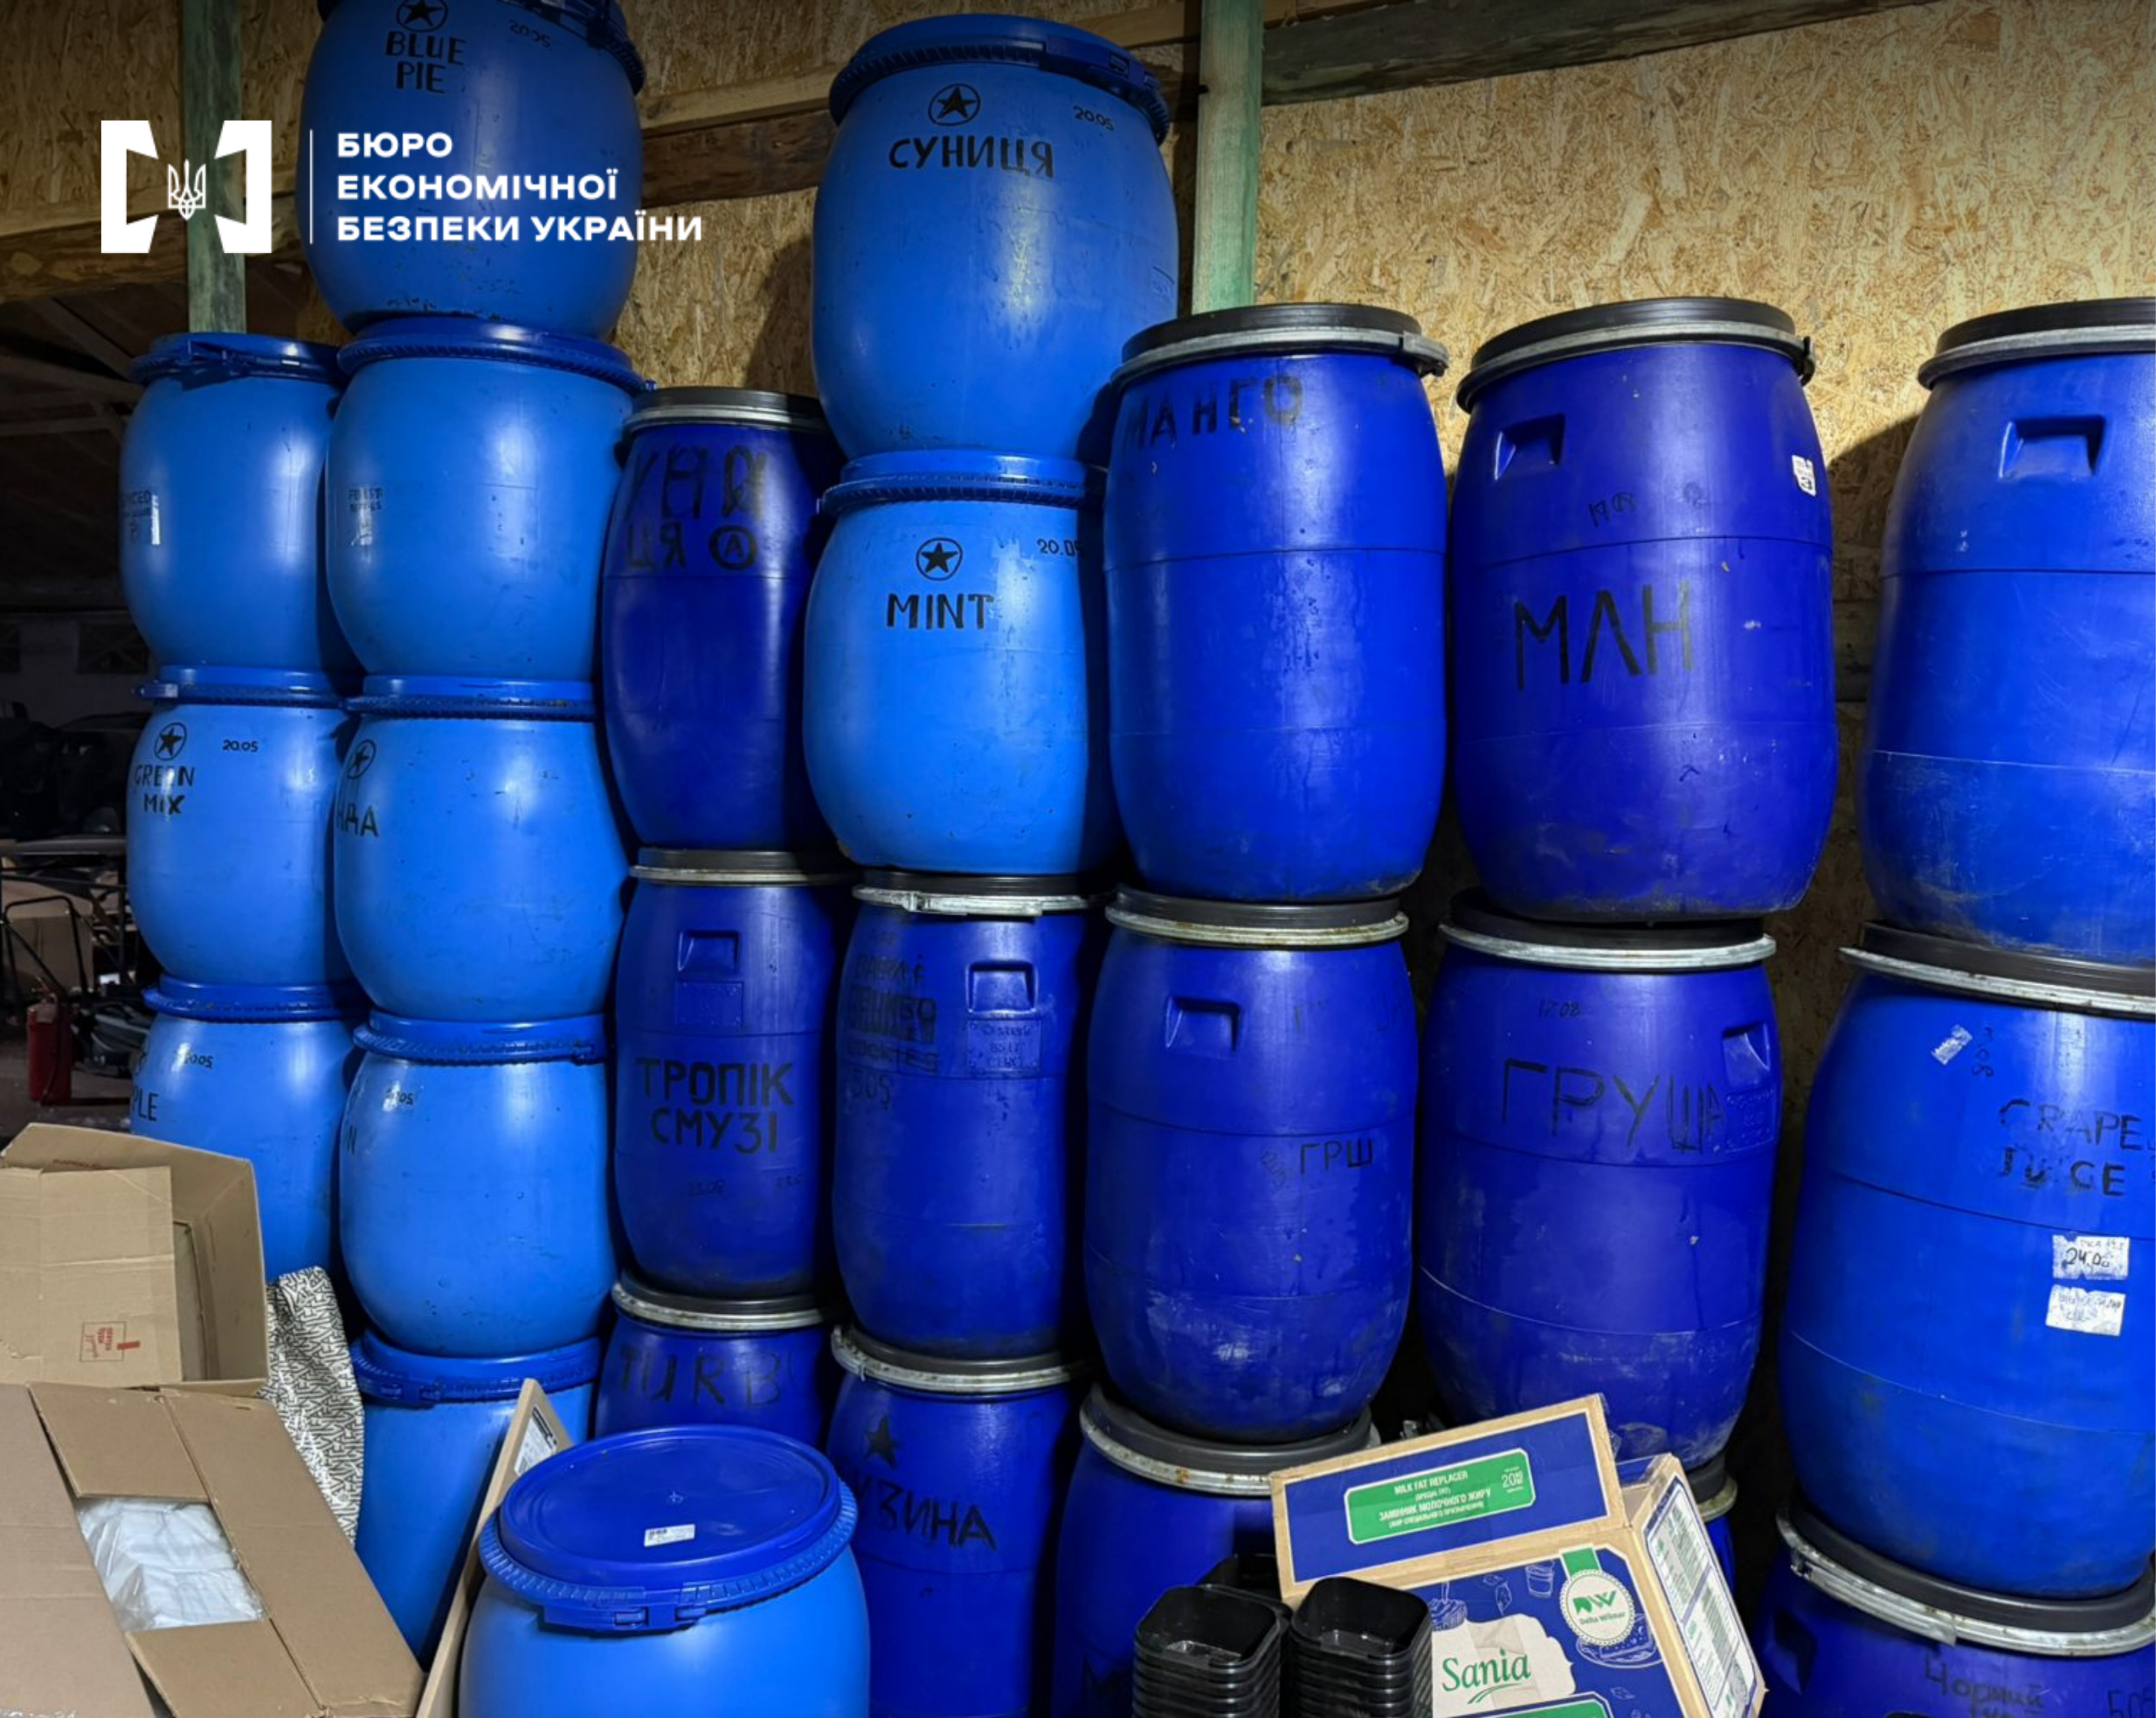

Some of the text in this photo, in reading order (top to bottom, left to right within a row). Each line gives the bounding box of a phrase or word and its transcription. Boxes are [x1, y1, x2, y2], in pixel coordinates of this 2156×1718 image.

[386, 31, 467, 66] BLUE
[396, 62, 446, 94] PIE
[888, 135, 1054, 178] СУНИЦЯ
[887, 593, 994, 630] MINT
[143, 792, 185, 815] MIX
[635, 1054, 795, 1108] ТРОПІК
[1502, 1057, 1723, 1155] ГРУША
[650, 1107, 778, 1155] СМУЗІ
[1300, 1137, 1373, 1175] ГРШ
[1996, 1145, 2126, 1197] JUCE
[1394, 1469, 1468, 1495] MILK FAT REPLACER
[1442, 1646, 1531, 1692] Sania
